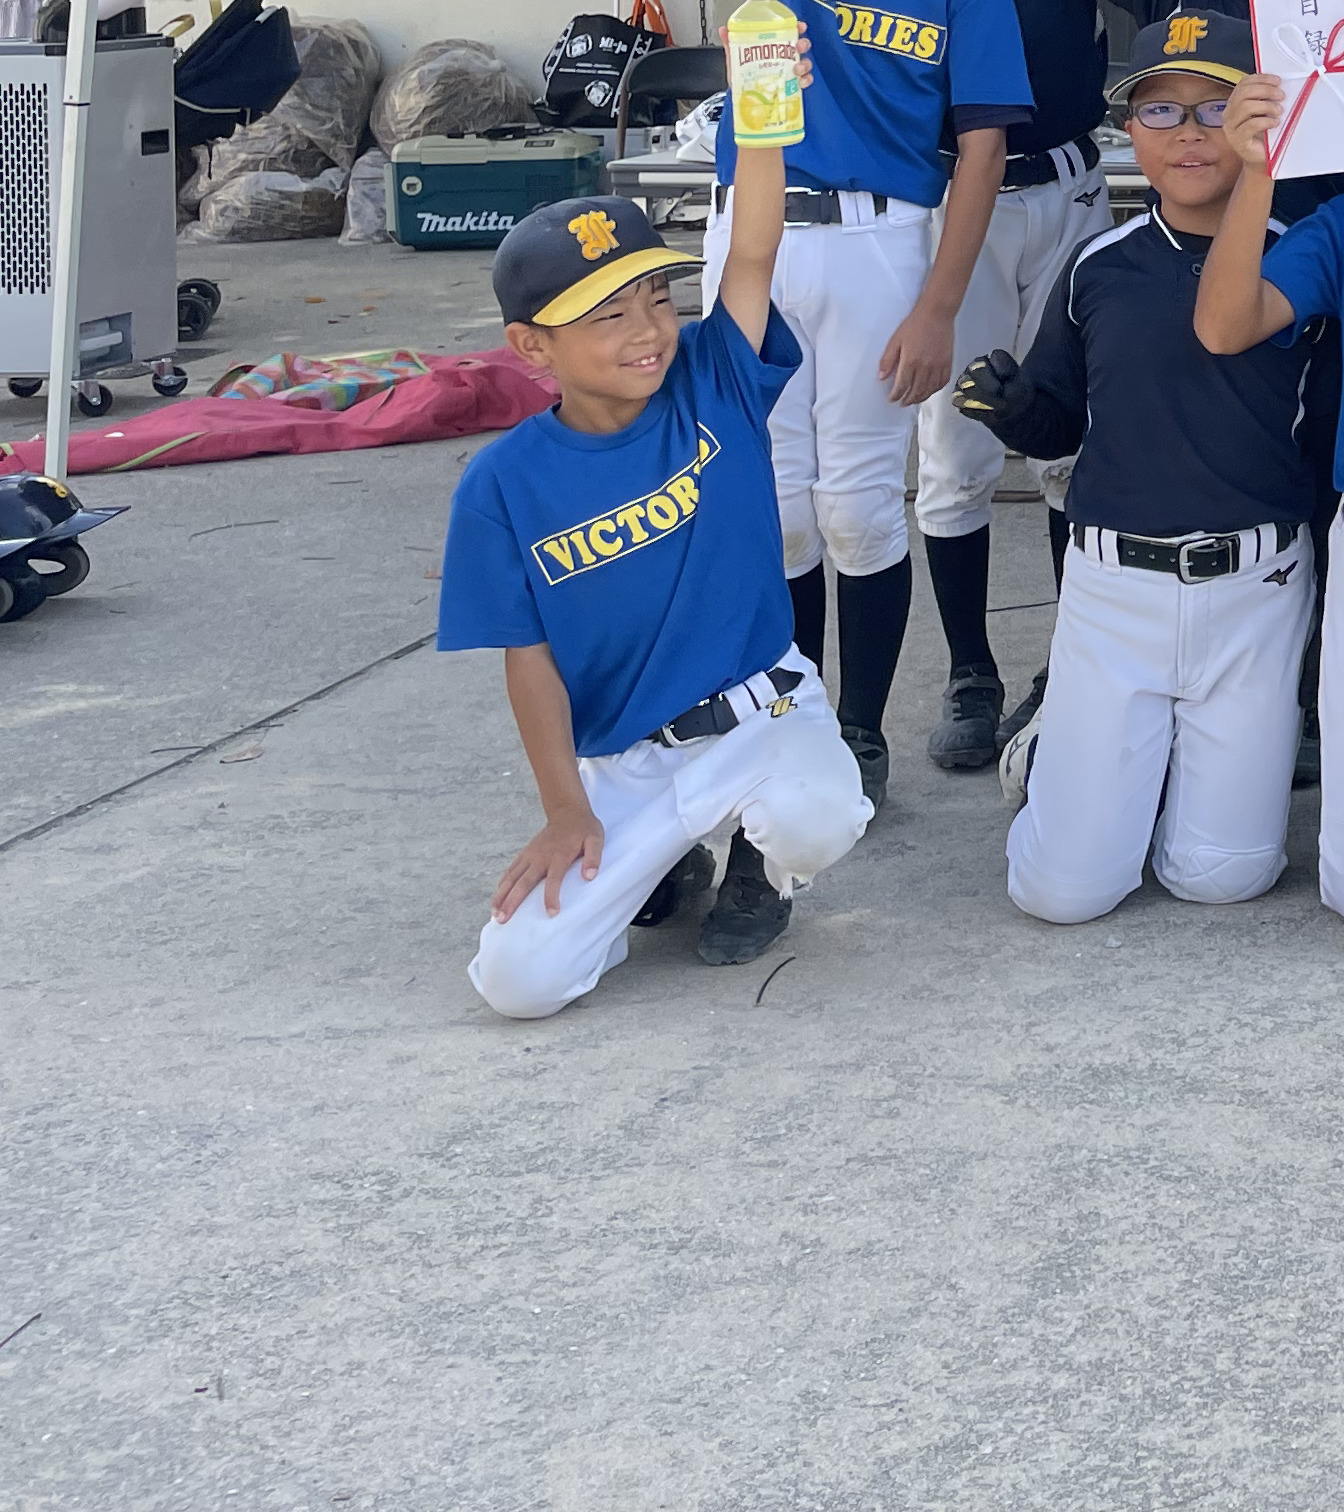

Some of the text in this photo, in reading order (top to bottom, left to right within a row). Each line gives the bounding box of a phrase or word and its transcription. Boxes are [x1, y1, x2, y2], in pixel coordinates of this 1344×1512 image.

[738, 41, 797, 66] Lemonade
[416, 210, 518, 233] makita
[543, 438, 710, 572] VICTOR
